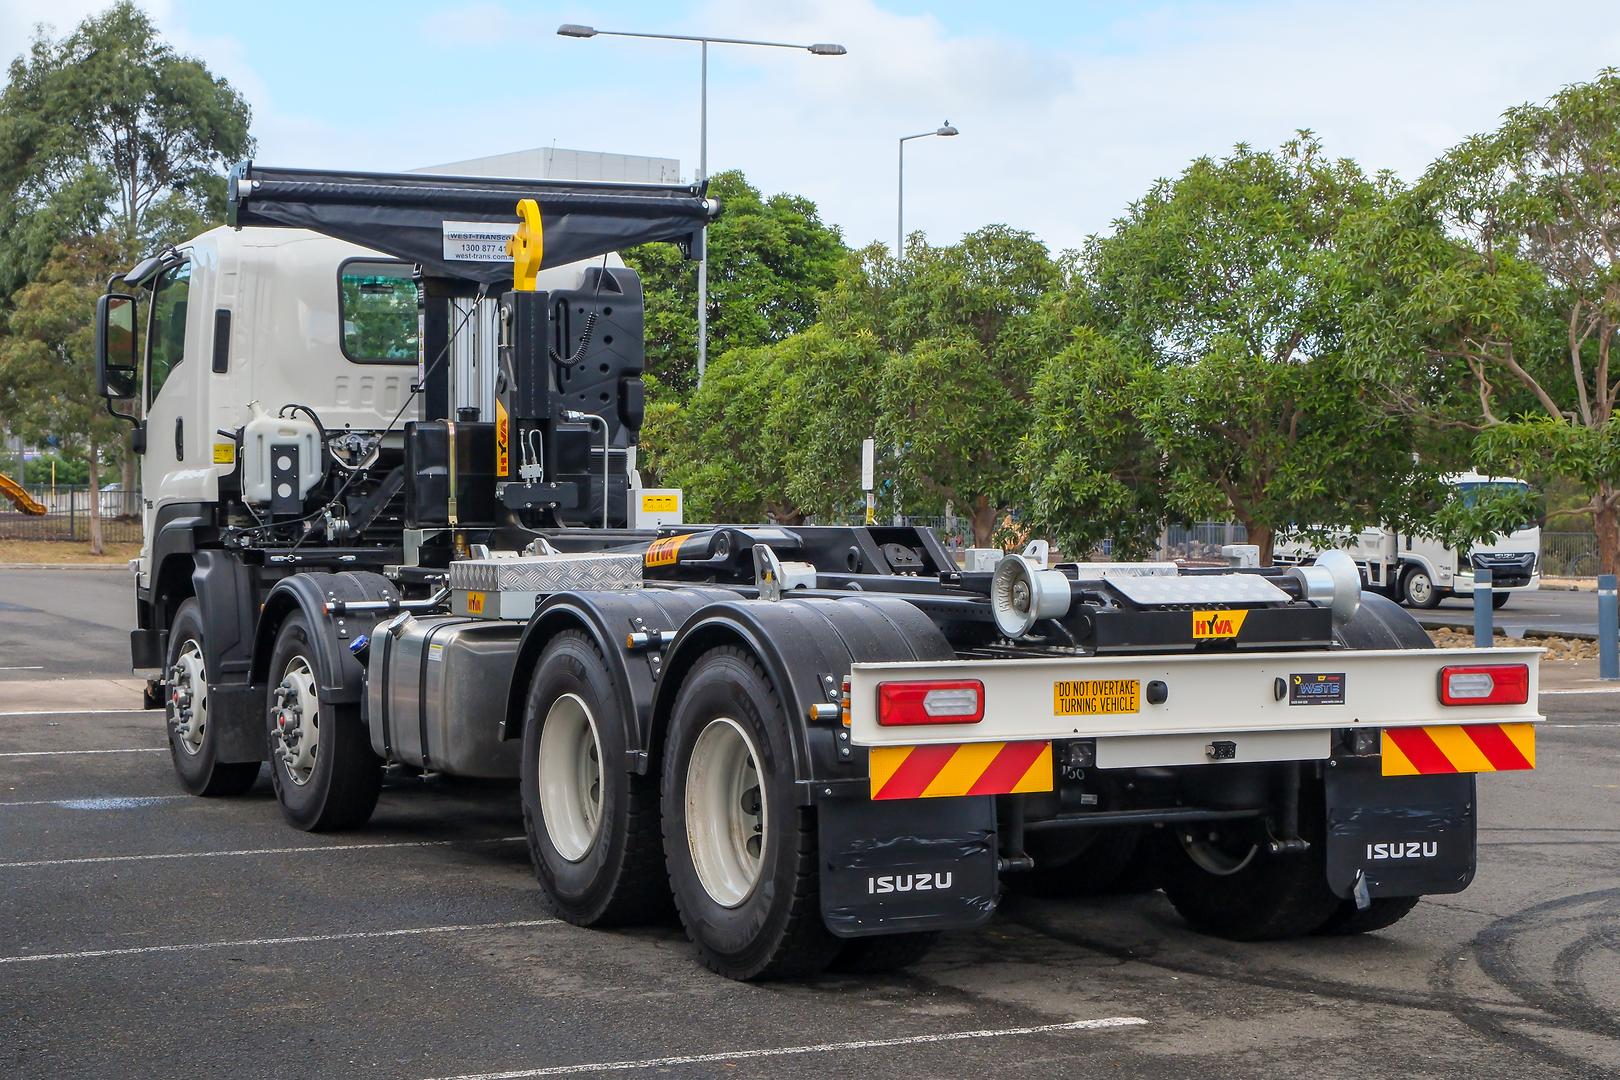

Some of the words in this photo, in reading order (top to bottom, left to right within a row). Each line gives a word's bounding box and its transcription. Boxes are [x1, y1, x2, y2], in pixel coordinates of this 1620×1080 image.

[450, 233, 511, 241] WEST-TRANSco
[455, 253, 514, 261] west-trans.com.a
[461, 244, 480, 252] 1300
[481, 245, 496, 253] 877
[498, 418, 507, 473] HYVA
[1195, 614, 1233, 635] HYVA
[1059, 681, 1071, 697] DO
[1073, 681, 1090, 697] NOT
[1092, 680, 1135, 696] OVERTAKE
[1300, 682, 1340, 694] WSTE
[1060, 697, 1097, 713] TURNING
[1100, 696, 1135, 712] VEHICLE
[1366, 841, 1438, 860] ISUZU
[868, 872, 952, 894] ISUZU
